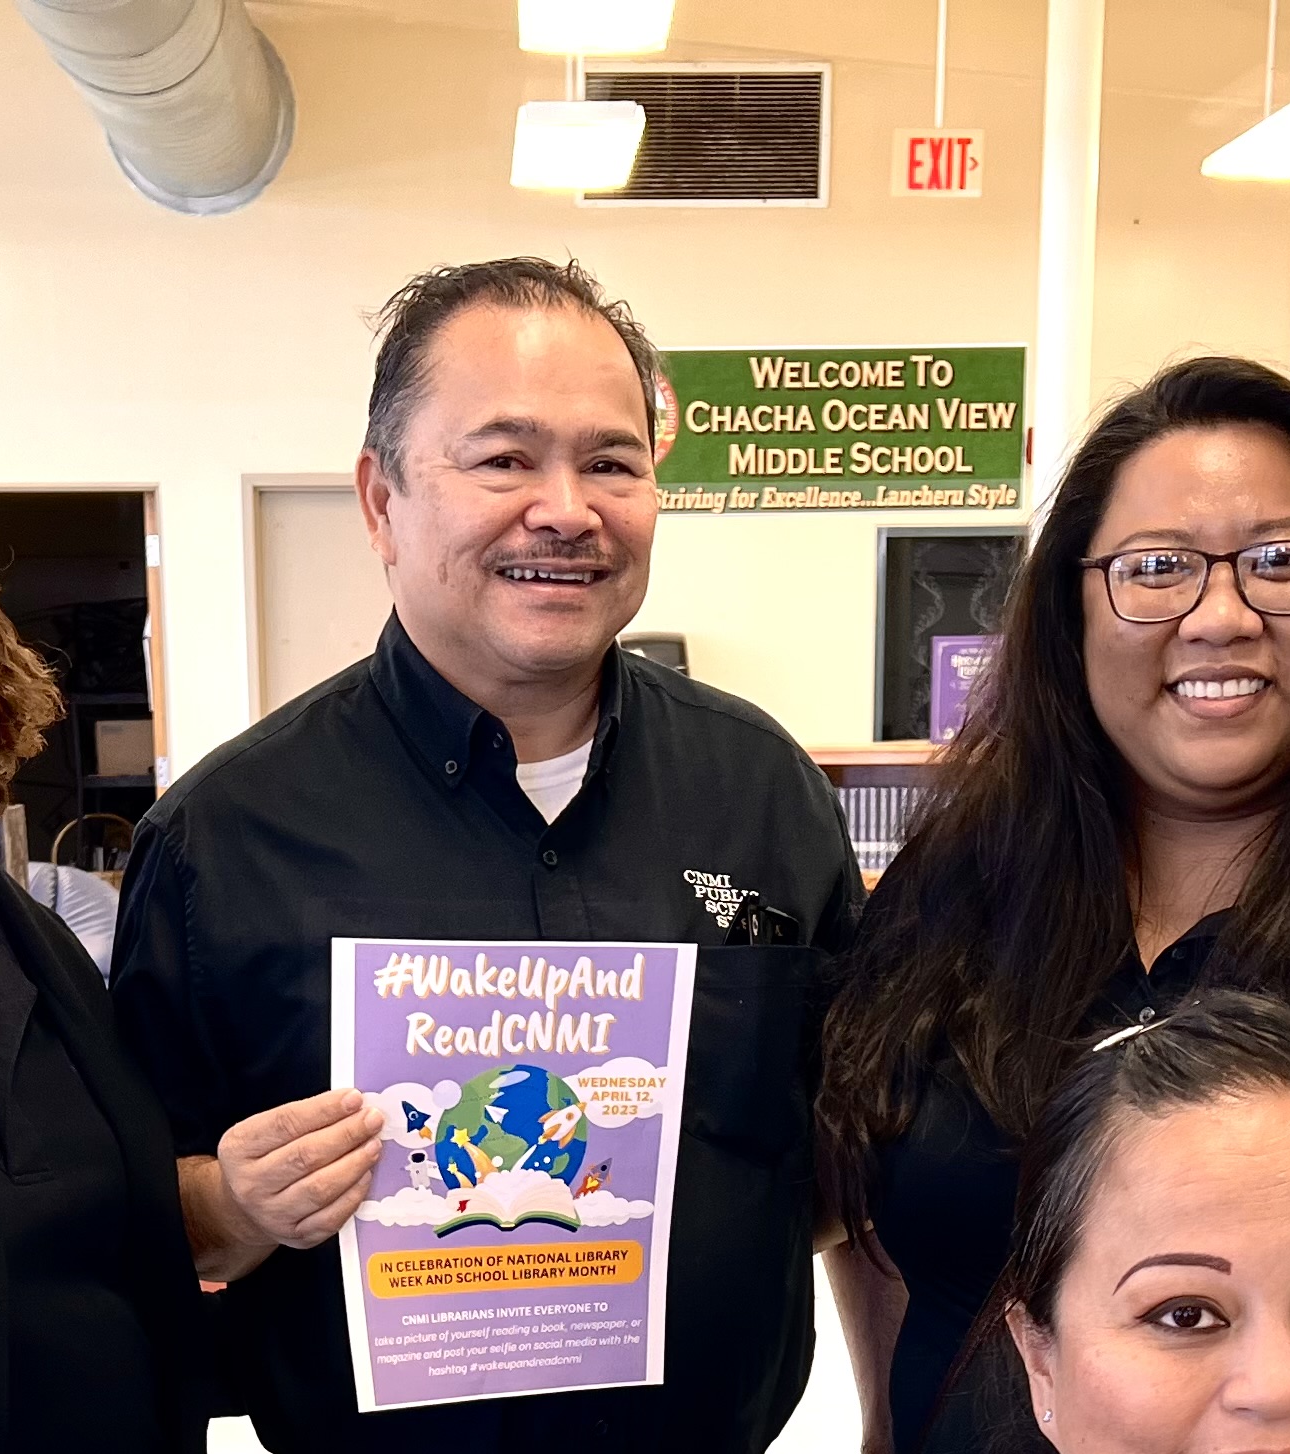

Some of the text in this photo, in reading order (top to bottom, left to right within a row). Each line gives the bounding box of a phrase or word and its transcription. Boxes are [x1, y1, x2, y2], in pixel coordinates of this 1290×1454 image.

[908, 138, 972, 190] EXIT
[749, 356, 905, 388] WELCOME
[685, 397, 1017, 433] CHACHA OCEAN VIEW
[728, 441, 974, 475] MIDDLE SCHOOL
[728, 487, 759, 509] for
[967, 484, 1017, 511] Style
[683, 869, 732, 888] CNMI
[374, 953, 645, 1009] #WakeUpAnd
[405, 1012, 616, 1057] ReadCNMI
[577, 1077, 667, 1089] WEDNESDAY
[590, 1090, 653, 1102] APRIL 12,
[601, 1104, 638, 1117] 2023
[380, 1249, 628, 1272] IN CELEBRATION OF NATIONAL LIBRARY
[388, 1264, 615, 1288] WEEK AND SCHOOL LIBRARY MONTH
